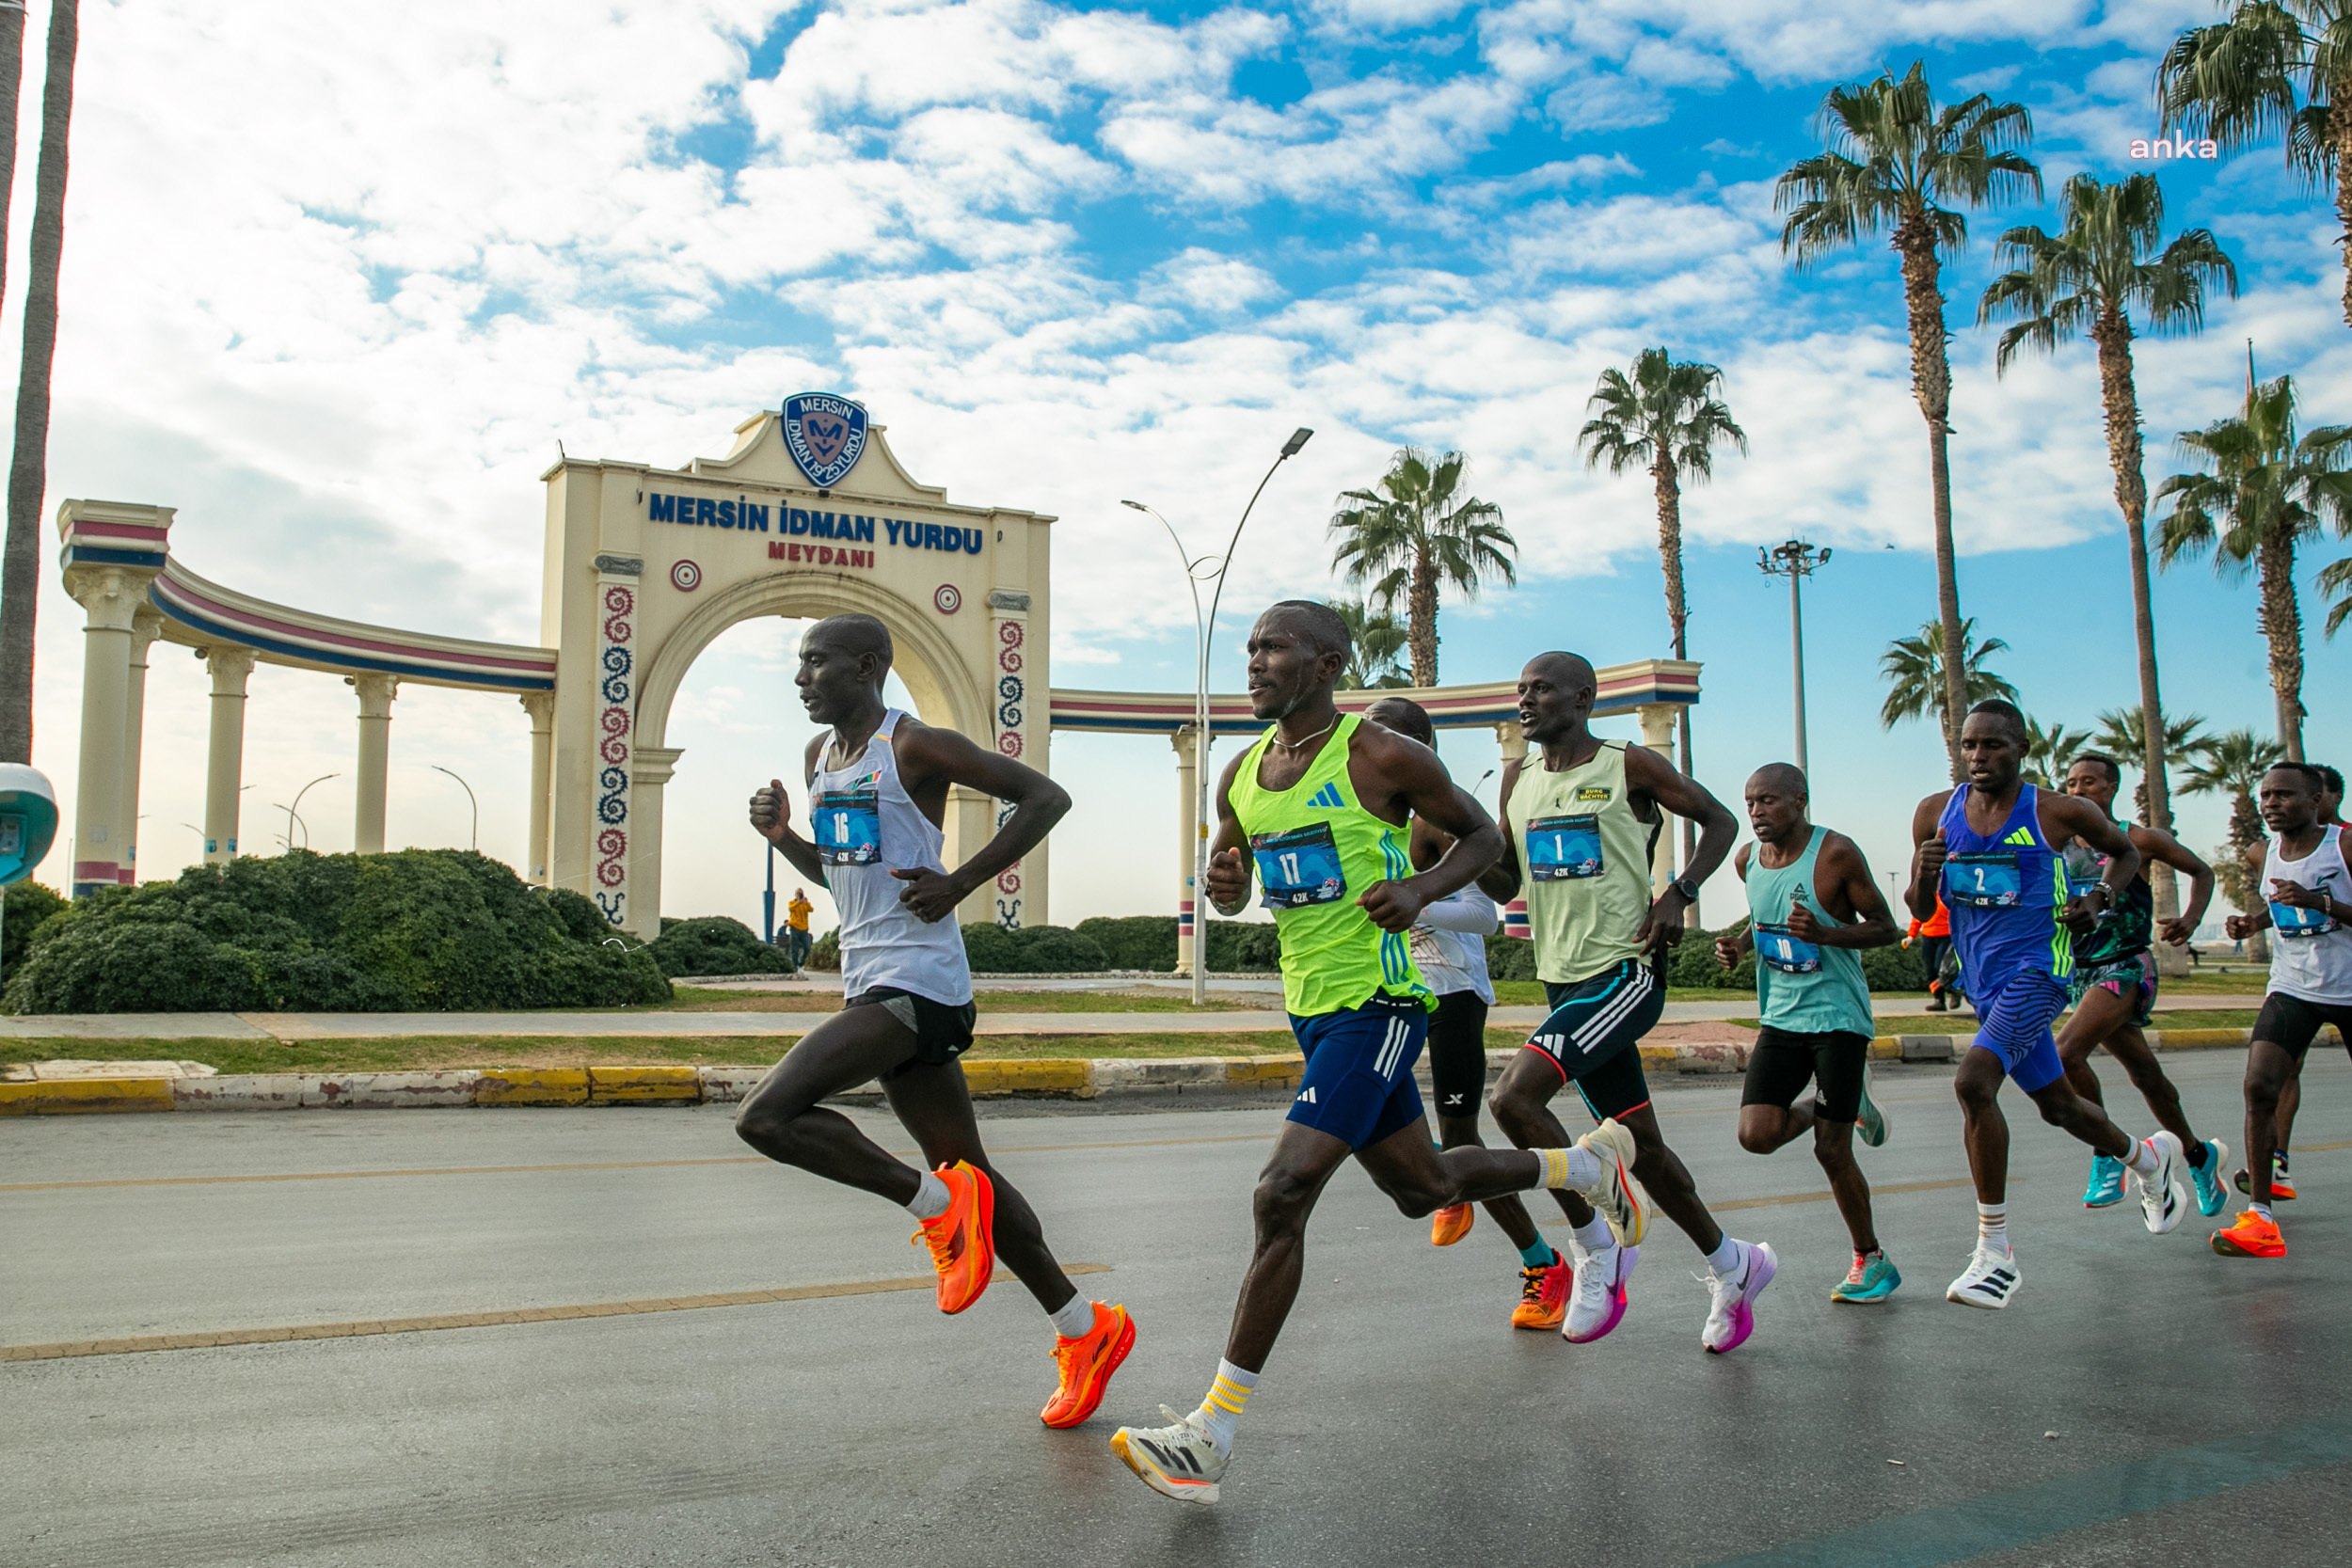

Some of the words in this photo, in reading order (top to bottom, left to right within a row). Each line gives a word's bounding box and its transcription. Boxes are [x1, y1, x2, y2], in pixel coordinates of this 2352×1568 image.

[809, 461, 840, 481] 1925
[837, 428, 863, 468] YURDU
[649, 493, 769, 531] MERSİN
[779, 499, 875, 543] İDMAN
[883, 518, 982, 554] YURDU
[769, 541, 875, 568] MEYDANI
[834, 812, 849, 844] 16
[1554, 834, 1564, 861] 1
[1279, 852, 1301, 885] 17
[1554, 867, 1569, 877] 42K
[1974, 867, 1986, 892] 2
[1293, 892, 1308, 903] 42K
[1975, 897, 1989, 906] 42K
[1777, 939, 1792, 959] 10
